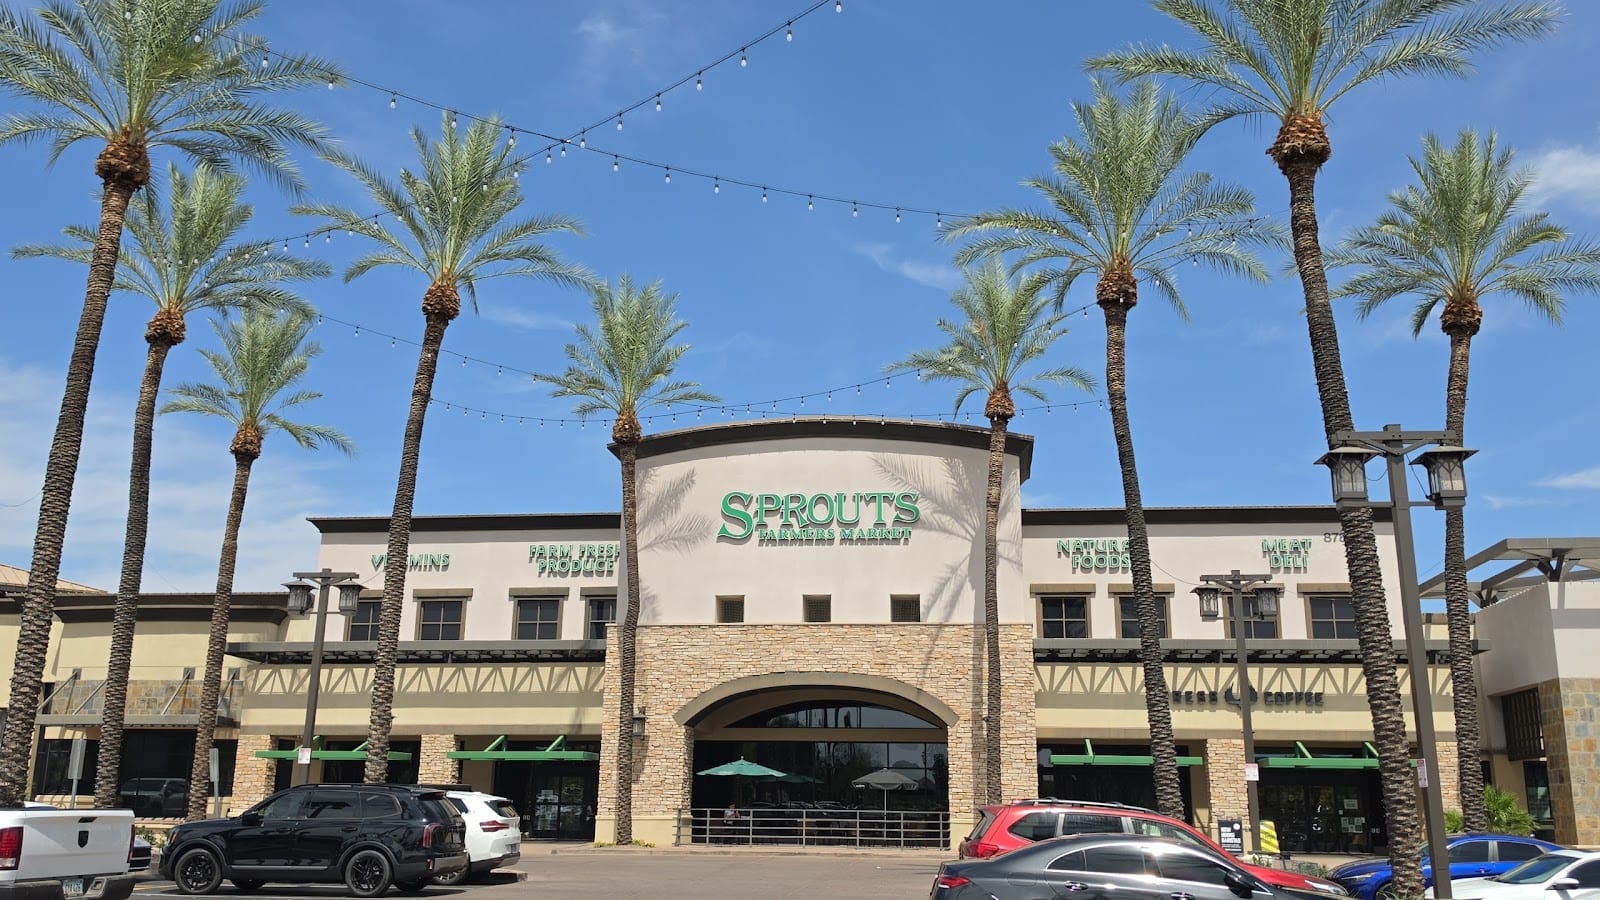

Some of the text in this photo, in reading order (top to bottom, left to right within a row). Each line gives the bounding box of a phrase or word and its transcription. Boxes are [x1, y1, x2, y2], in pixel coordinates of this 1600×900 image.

[717, 491, 920, 539] SPROUTS
[758, 527, 912, 540] FARMERS MARKET
[529, 544, 573, 556] FARM
[1057, 538, 1130, 552] NATURA
[1263, 538, 1312, 552] MEAT
[371, 553, 450, 567] VIMINS
[538, 559, 614, 572] PRODUCE
[1072, 554, 1130, 568] FOODS
[1270, 554, 1309, 568] DELI
[1172, 690, 1324, 706] RESS COFFEE
